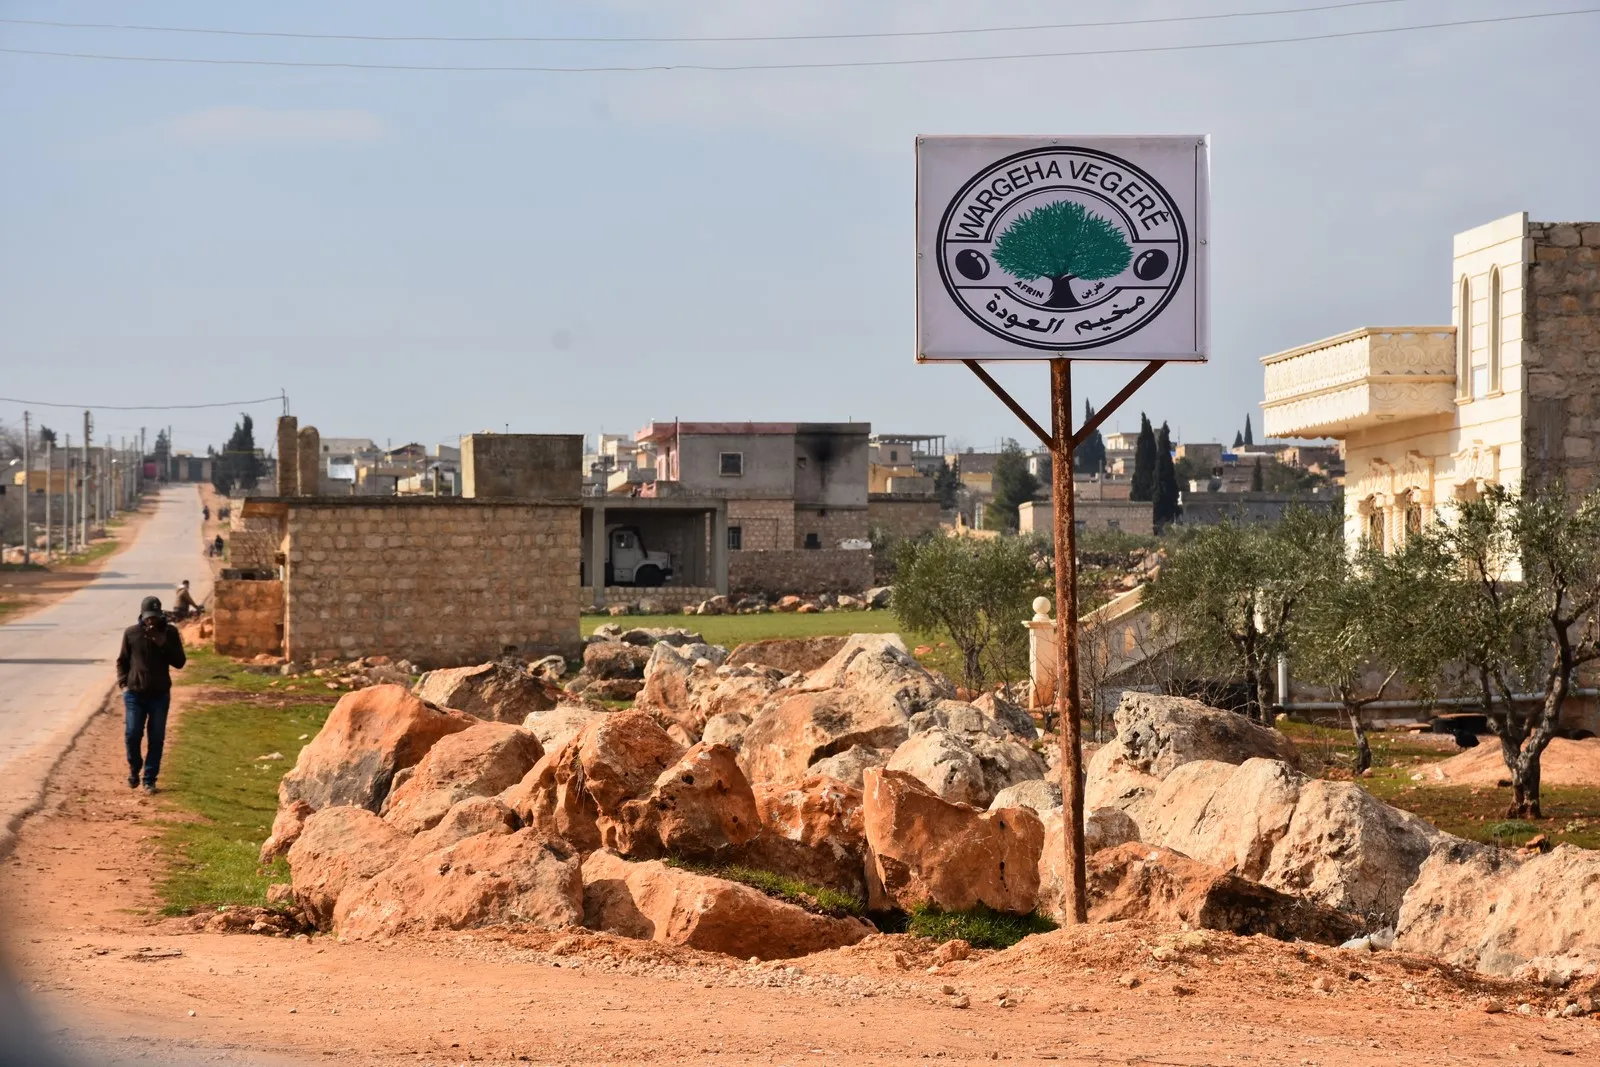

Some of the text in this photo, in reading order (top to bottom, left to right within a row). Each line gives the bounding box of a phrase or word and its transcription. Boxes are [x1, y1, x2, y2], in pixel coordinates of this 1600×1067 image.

[955, 160, 1170, 239] WARGEHA VEGERÊ
[1014, 281, 1044, 299] AFRIN
[1081, 281, 1105, 299] عفرين
[985, 293, 1145, 335] مخيم العودة
